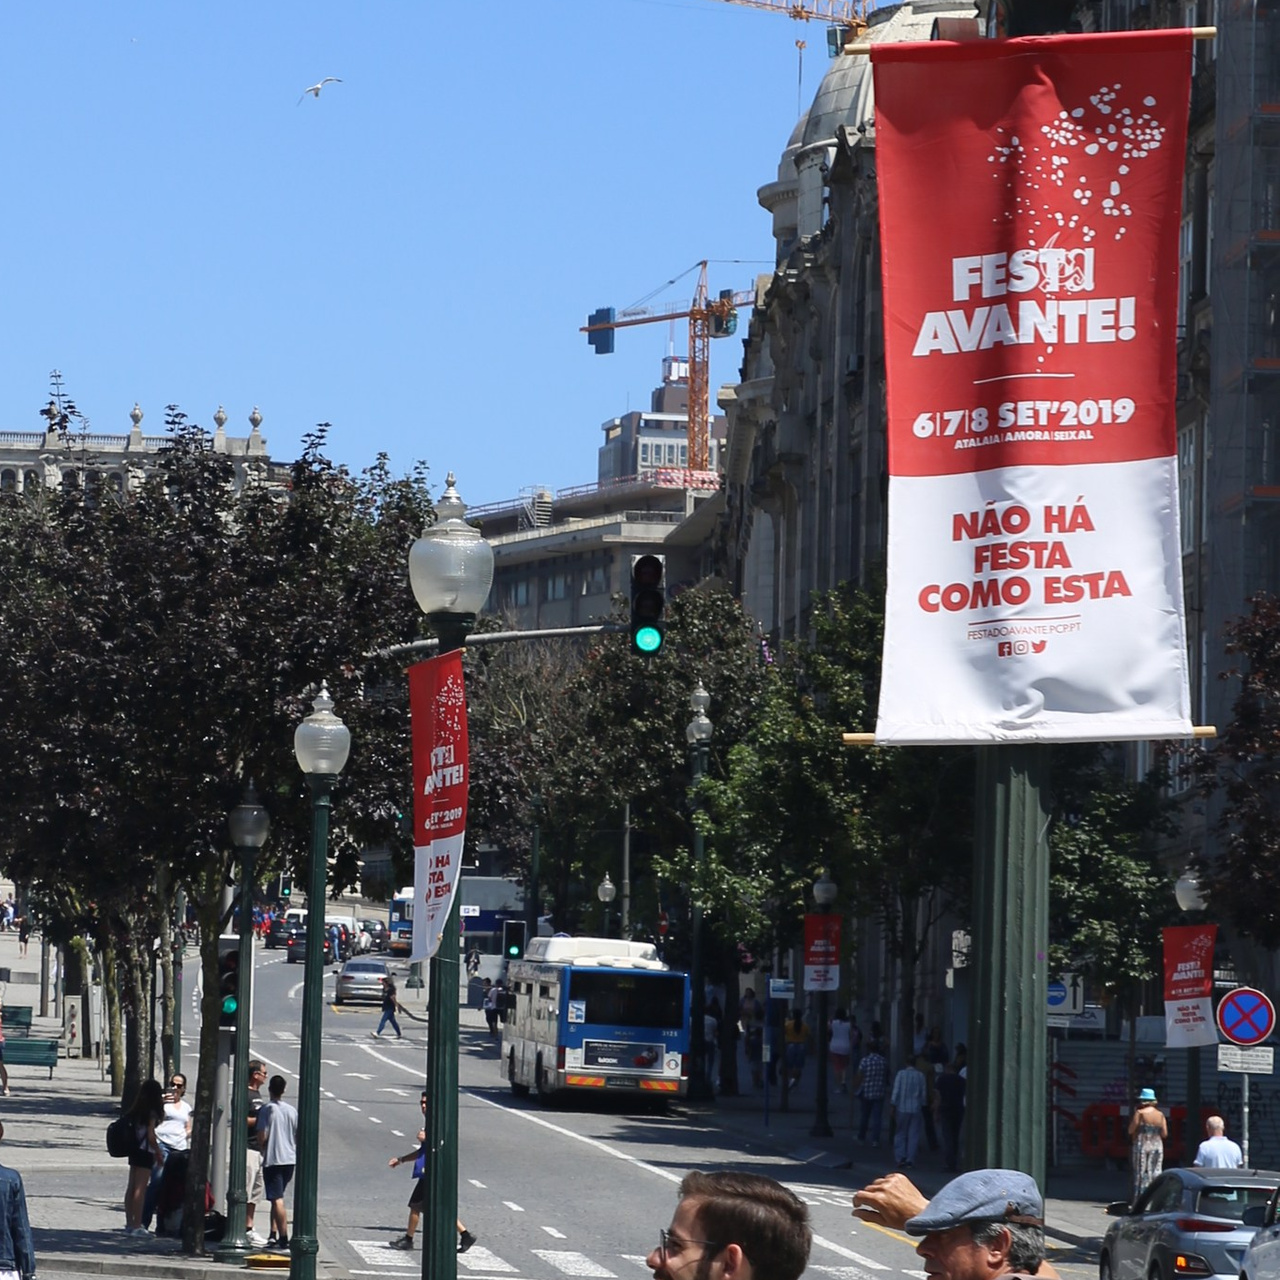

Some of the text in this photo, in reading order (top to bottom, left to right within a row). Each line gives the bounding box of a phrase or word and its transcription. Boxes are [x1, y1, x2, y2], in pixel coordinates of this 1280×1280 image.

[912, 296, 1136, 357] AVANTE!
[951, 494, 1096, 542] NÃO HÁ
[974, 540, 1073, 574] FESTA
[917, 569, 1133, 613] COMO ESTA
[967, 621, 1082, 641] FESTADOAVANTE.PCP.PT
